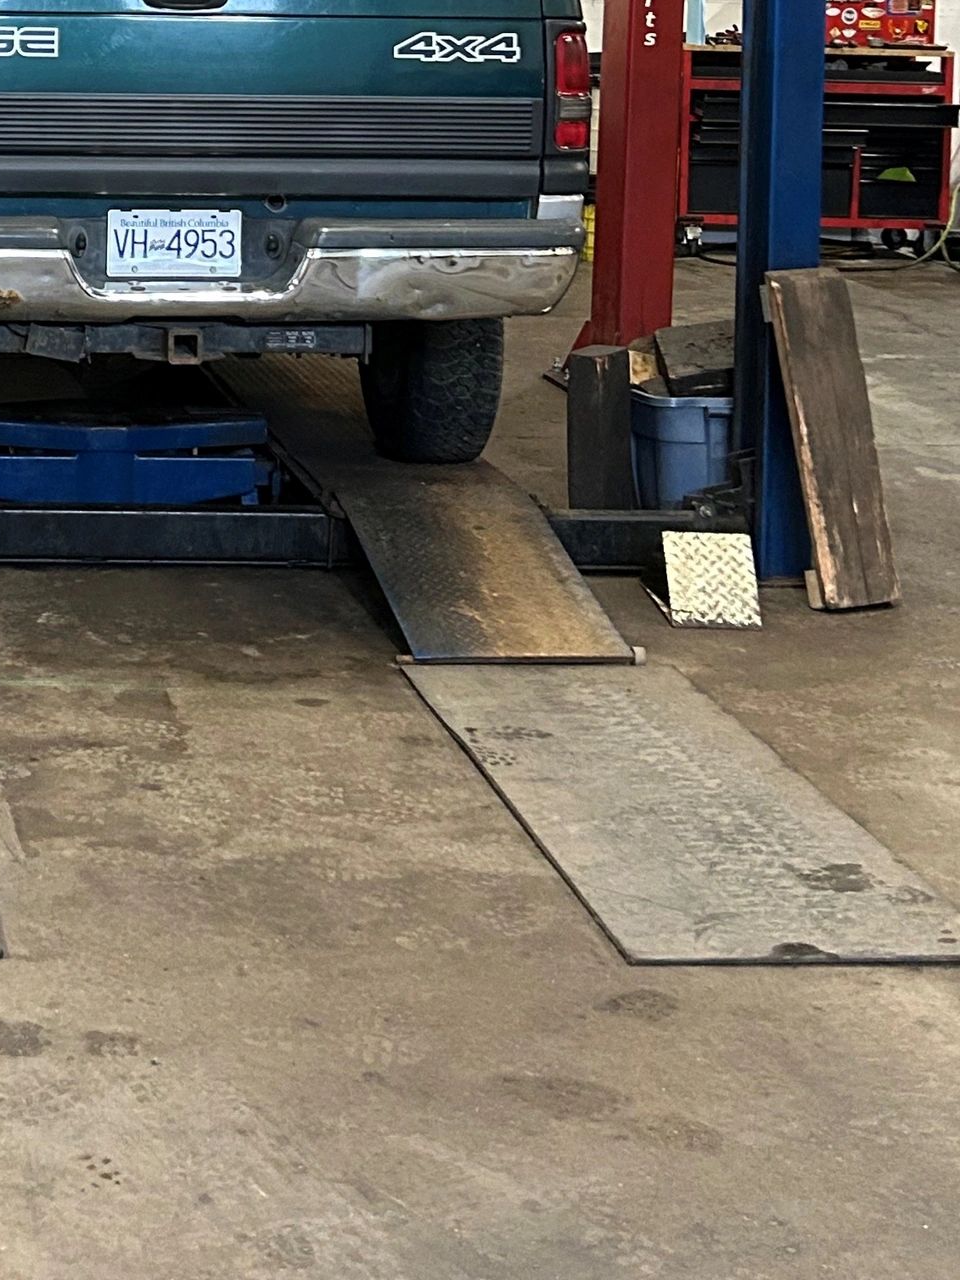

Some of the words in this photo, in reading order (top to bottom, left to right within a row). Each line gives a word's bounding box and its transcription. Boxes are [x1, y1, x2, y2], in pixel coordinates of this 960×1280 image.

[120, 218, 158, 228] Beautiful
[160, 218, 186, 228] British
[187, 219, 229, 228] Columbia
[113, 228, 148, 259] VH
[165, 228, 236, 260] 4953
